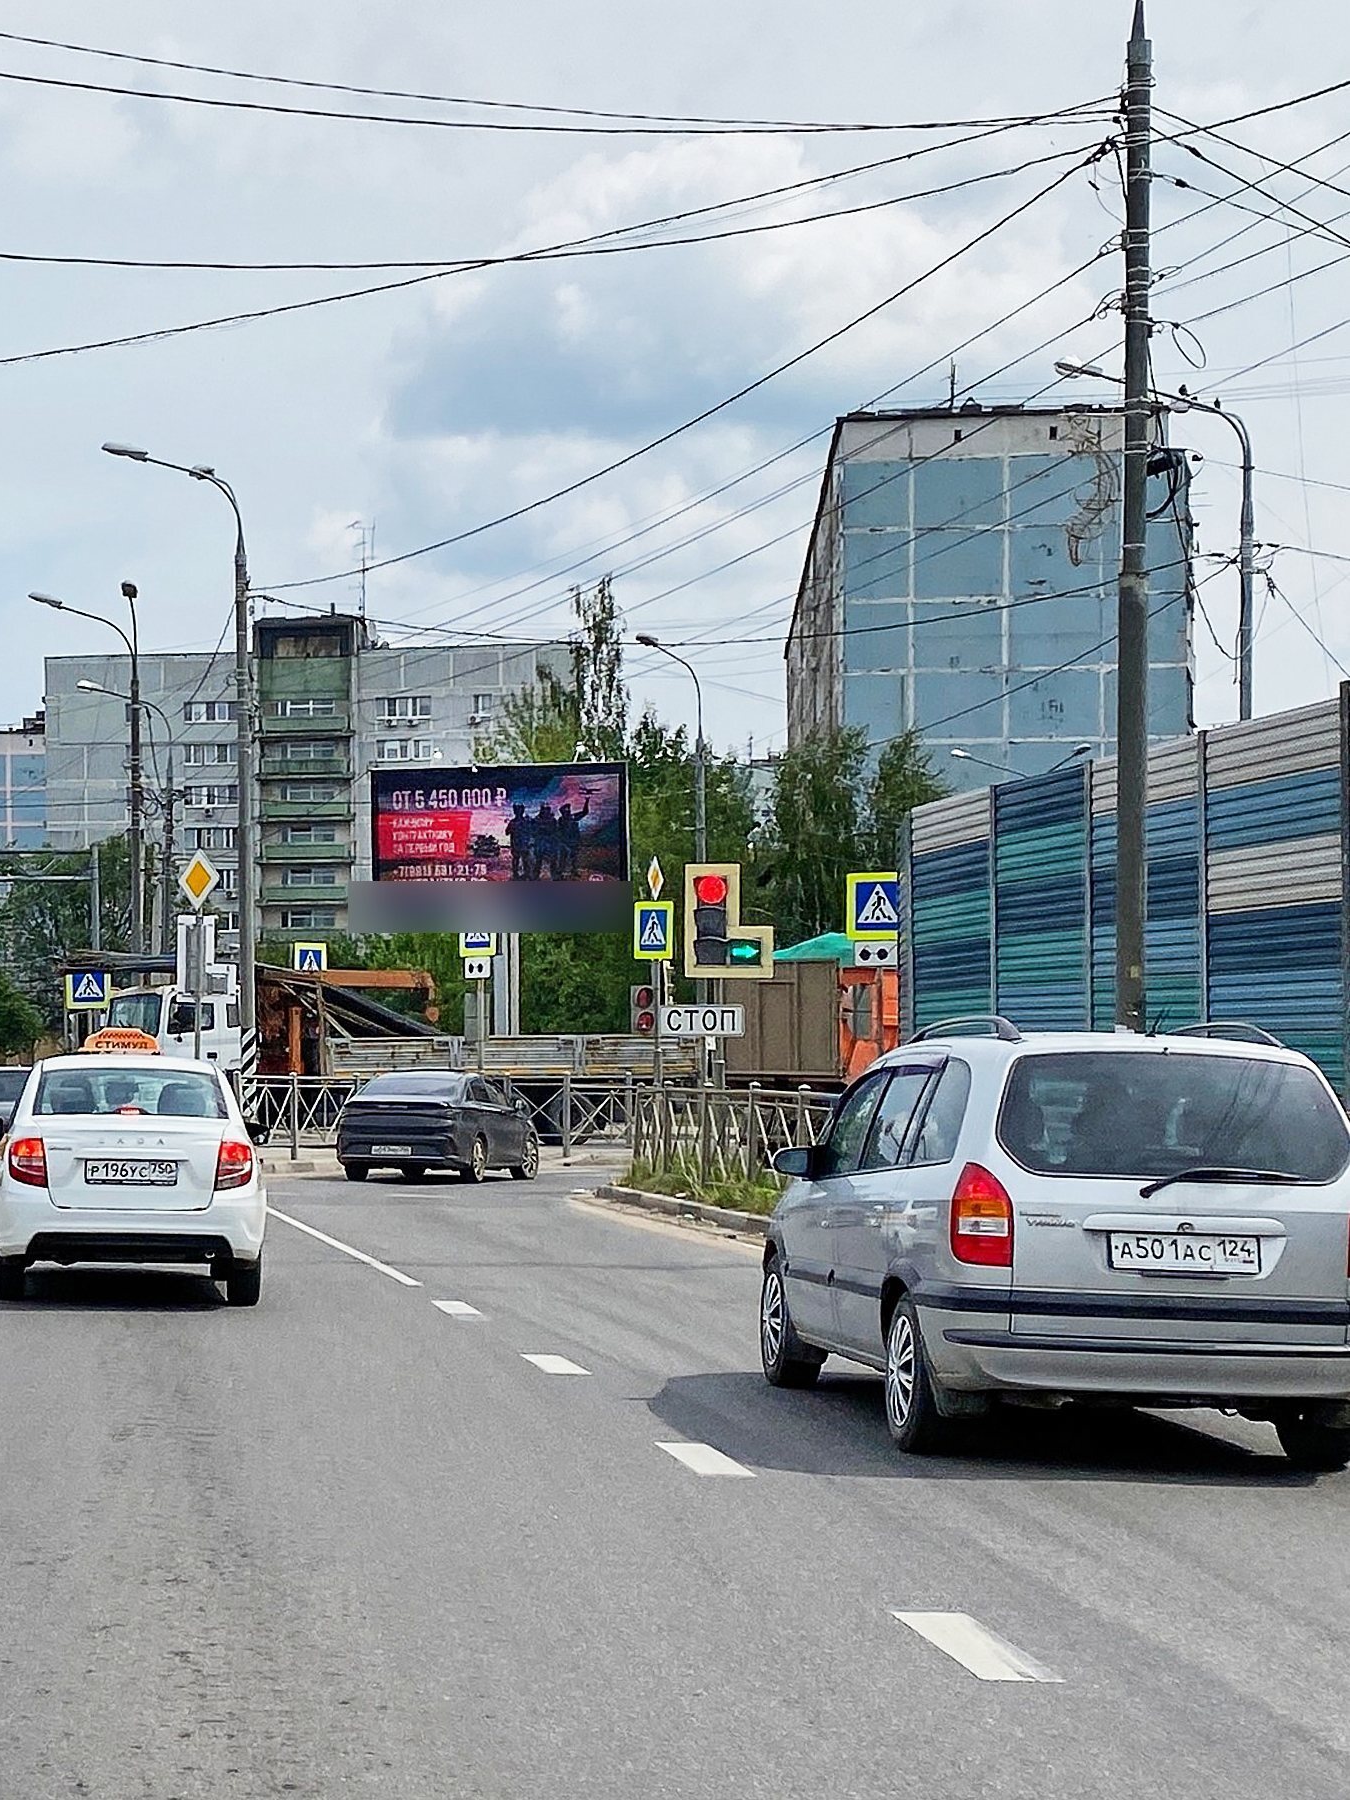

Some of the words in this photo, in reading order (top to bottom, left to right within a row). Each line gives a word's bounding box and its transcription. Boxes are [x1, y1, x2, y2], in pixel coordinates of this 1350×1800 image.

[392, 790, 412, 810] ОТ
[415, 790, 425, 809] 5
[428, 789, 458, 809] 450
[462, 788, 492, 808] 000
[667, 1009, 736, 1032] СТОП
